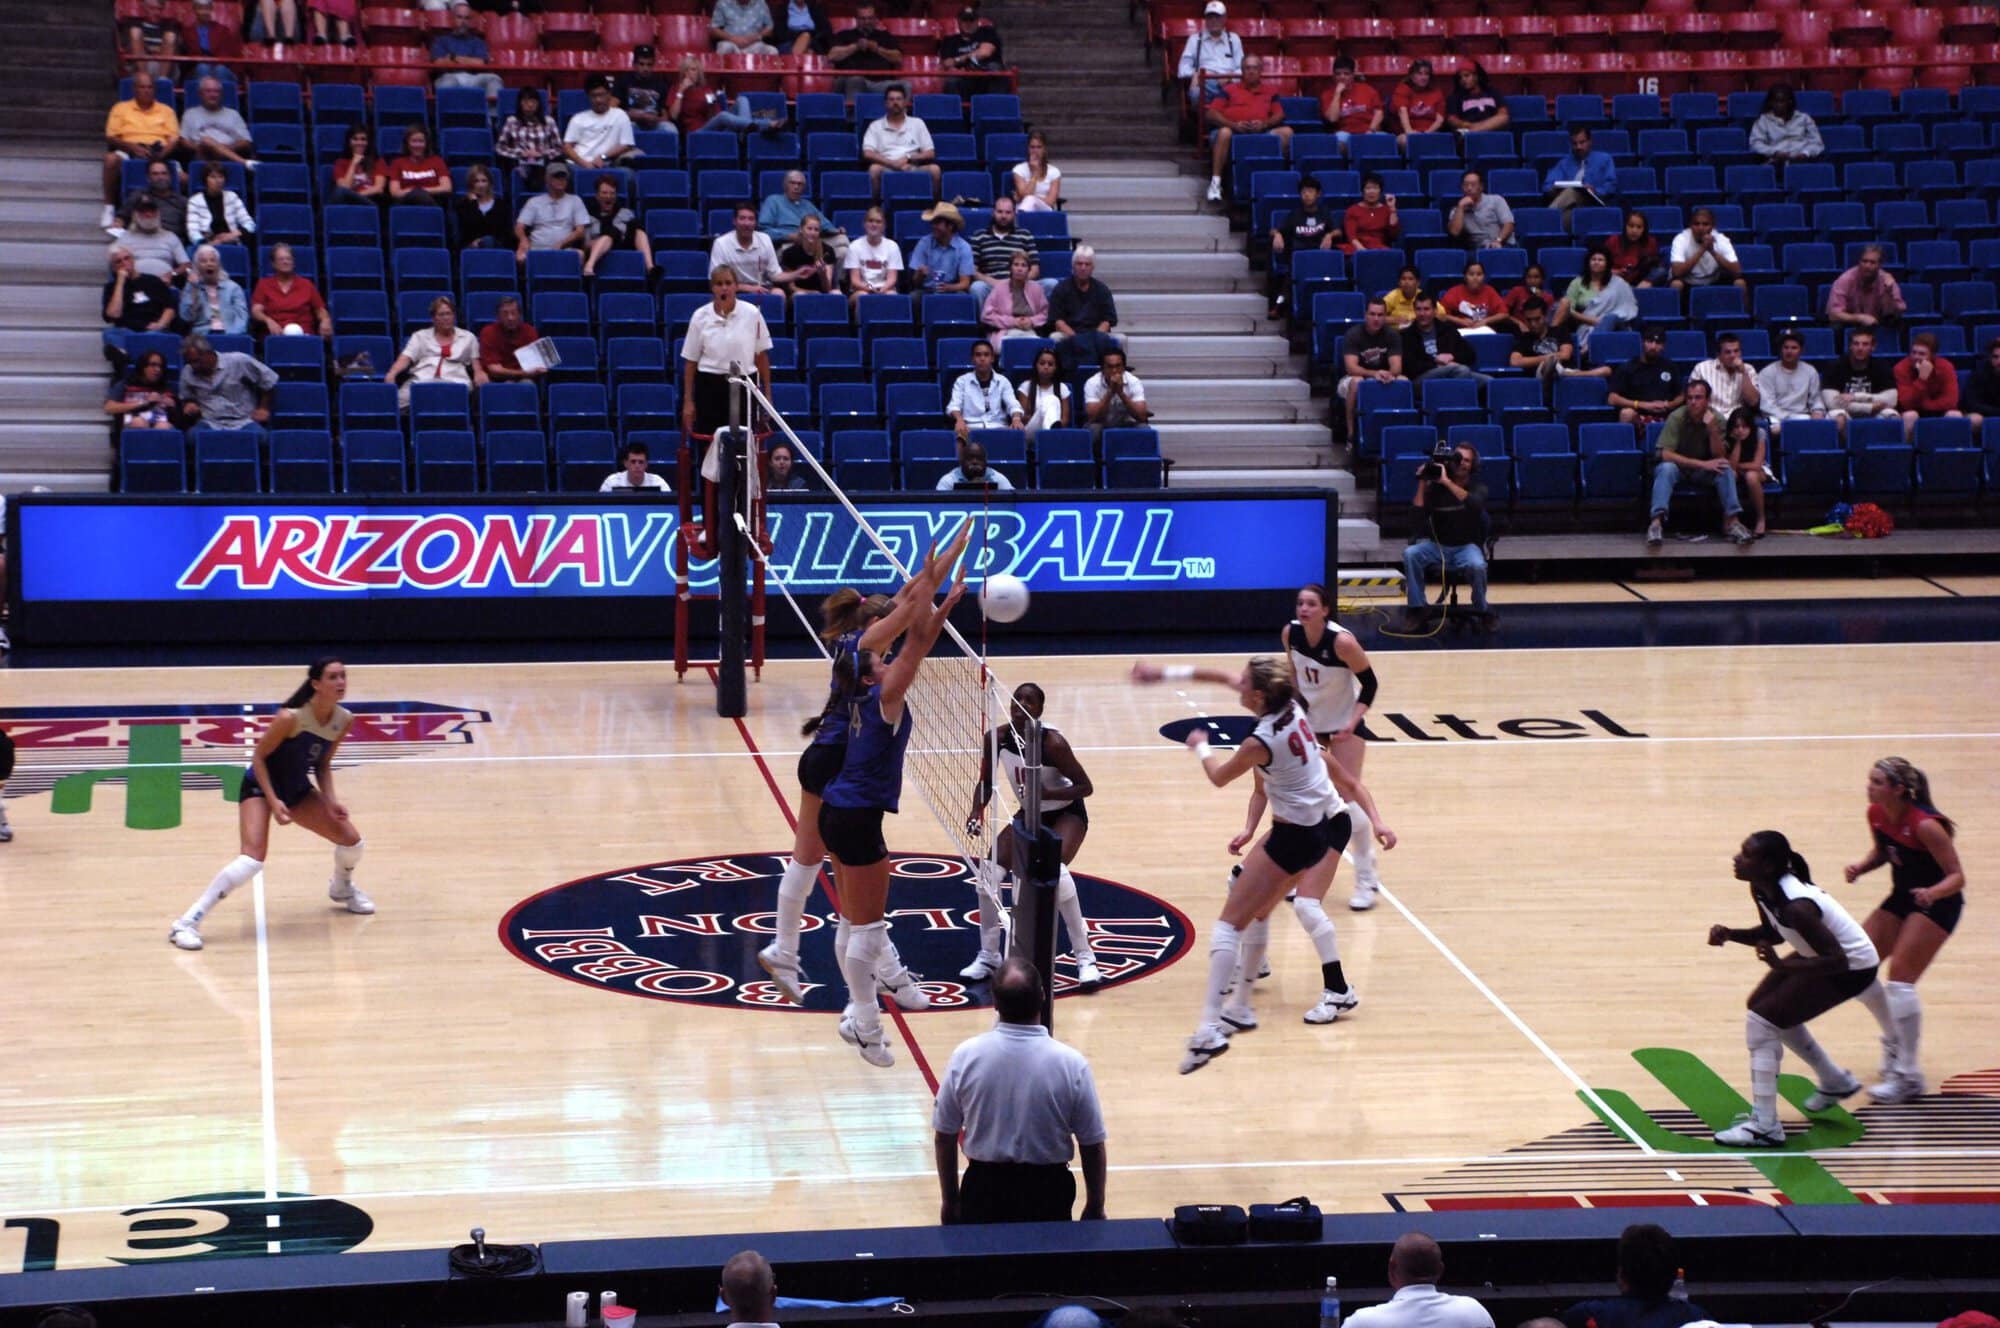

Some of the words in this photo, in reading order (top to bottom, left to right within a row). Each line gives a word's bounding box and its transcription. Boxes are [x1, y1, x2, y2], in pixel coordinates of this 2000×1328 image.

[1638, 77, 1659, 95] 16
[176, 514, 605, 590] ARIZONA
[1304, 666, 1319, 684] 17
[522, 927, 827, 1007] BOBBI
